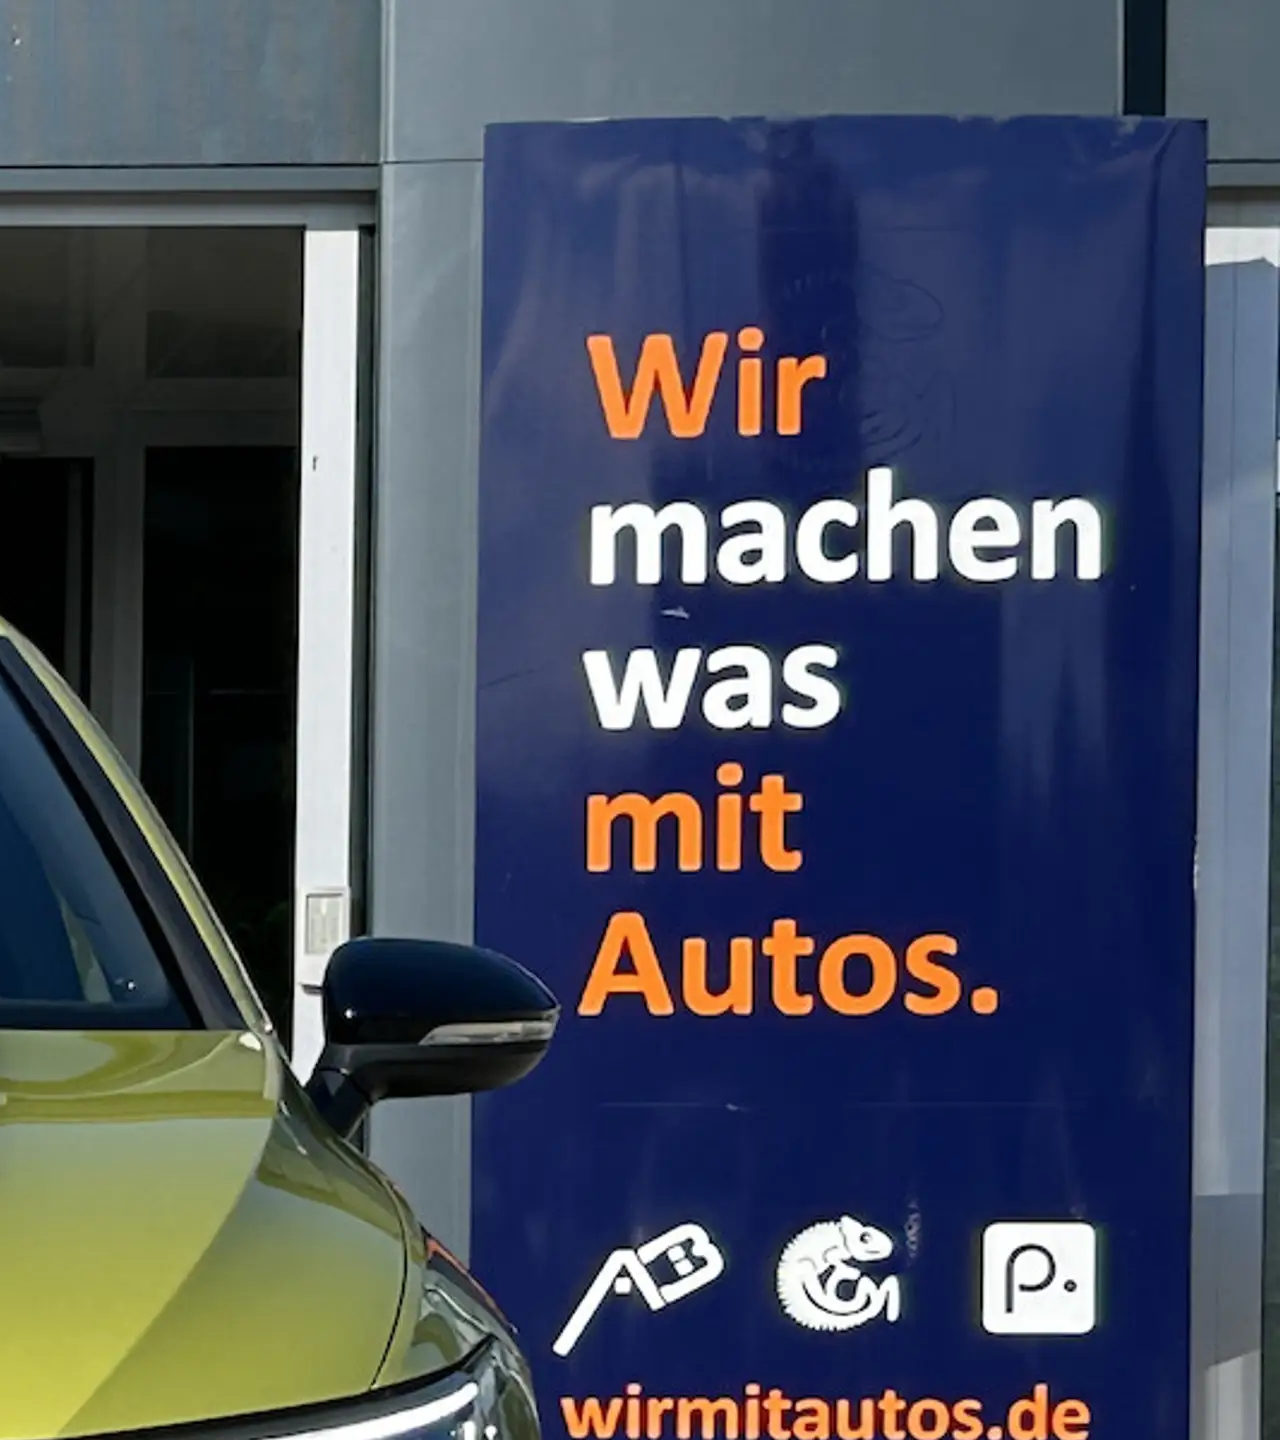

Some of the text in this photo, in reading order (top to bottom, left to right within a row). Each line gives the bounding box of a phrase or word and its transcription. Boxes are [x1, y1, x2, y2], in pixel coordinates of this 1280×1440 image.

[586, 326, 827, 440] Wir
[589, 466, 1103, 586] machen
[582, 644, 842, 730] was
[586, 761, 804, 873] mit
[577, 911, 999, 1017] Autos.
